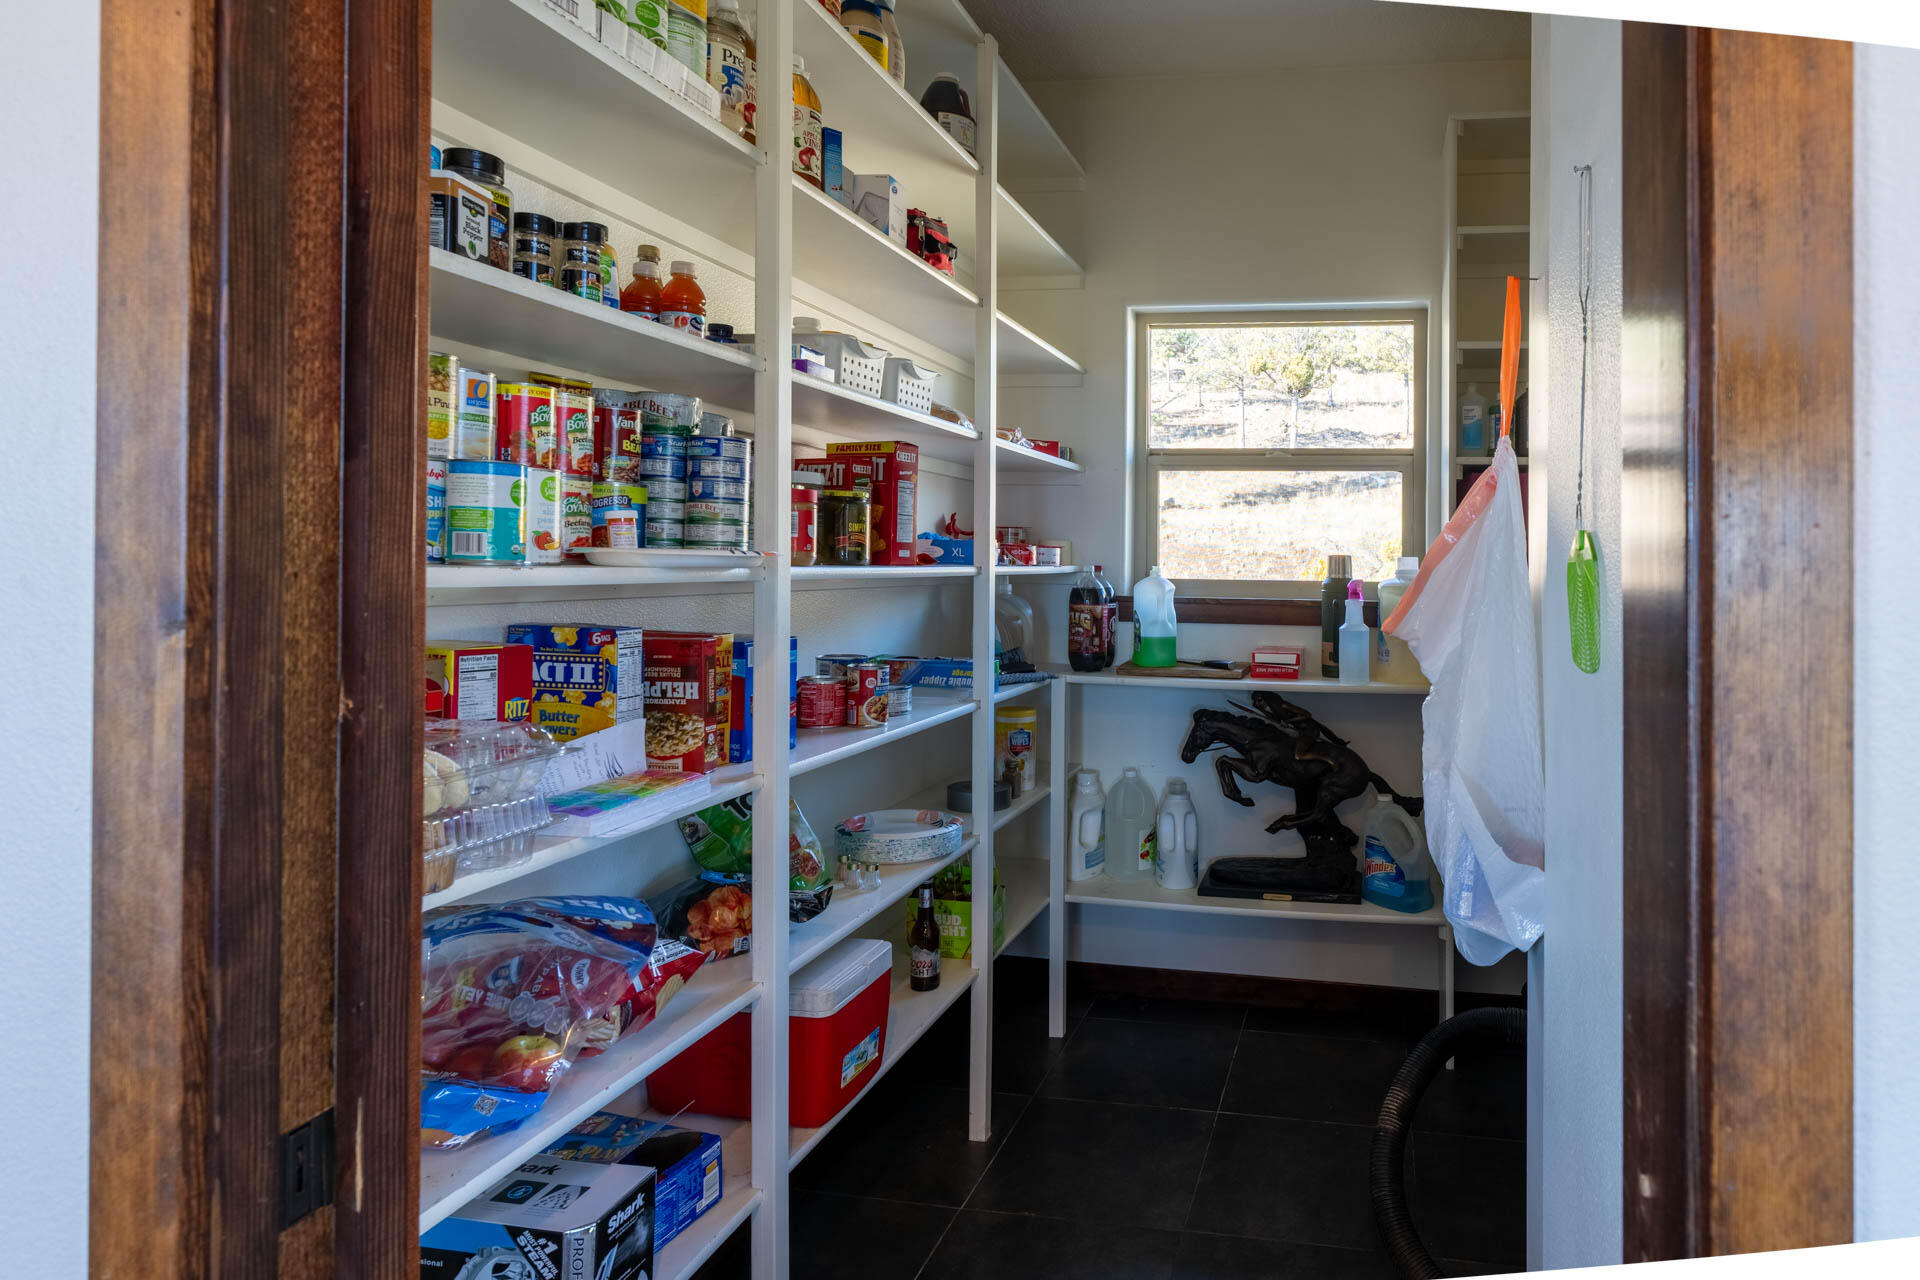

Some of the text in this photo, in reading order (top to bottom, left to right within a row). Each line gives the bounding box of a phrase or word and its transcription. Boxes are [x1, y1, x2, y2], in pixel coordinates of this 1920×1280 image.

[722, 48, 744, 68] Pre
[465, 221, 482, 235] Black
[463, 227, 483, 242] Pepper
[560, 386, 592, 395] Rosar
[836, 443, 882, 453] FAMILY SIZE
[592, 496, 628, 508] OGRESSO
[848, 522, 867, 532] SIMPL
[952, 547, 965, 557] XL
[592, 632, 601, 644] 6
[948, 677, 973, 687] ouble
[642, 681, 699, 700] HELPE
[504, 699, 530, 719] RITZ
[539, 709, 580, 723] Butter
[545, 725, 578, 737] overs
[607, 1192, 646, 1235] Shark
